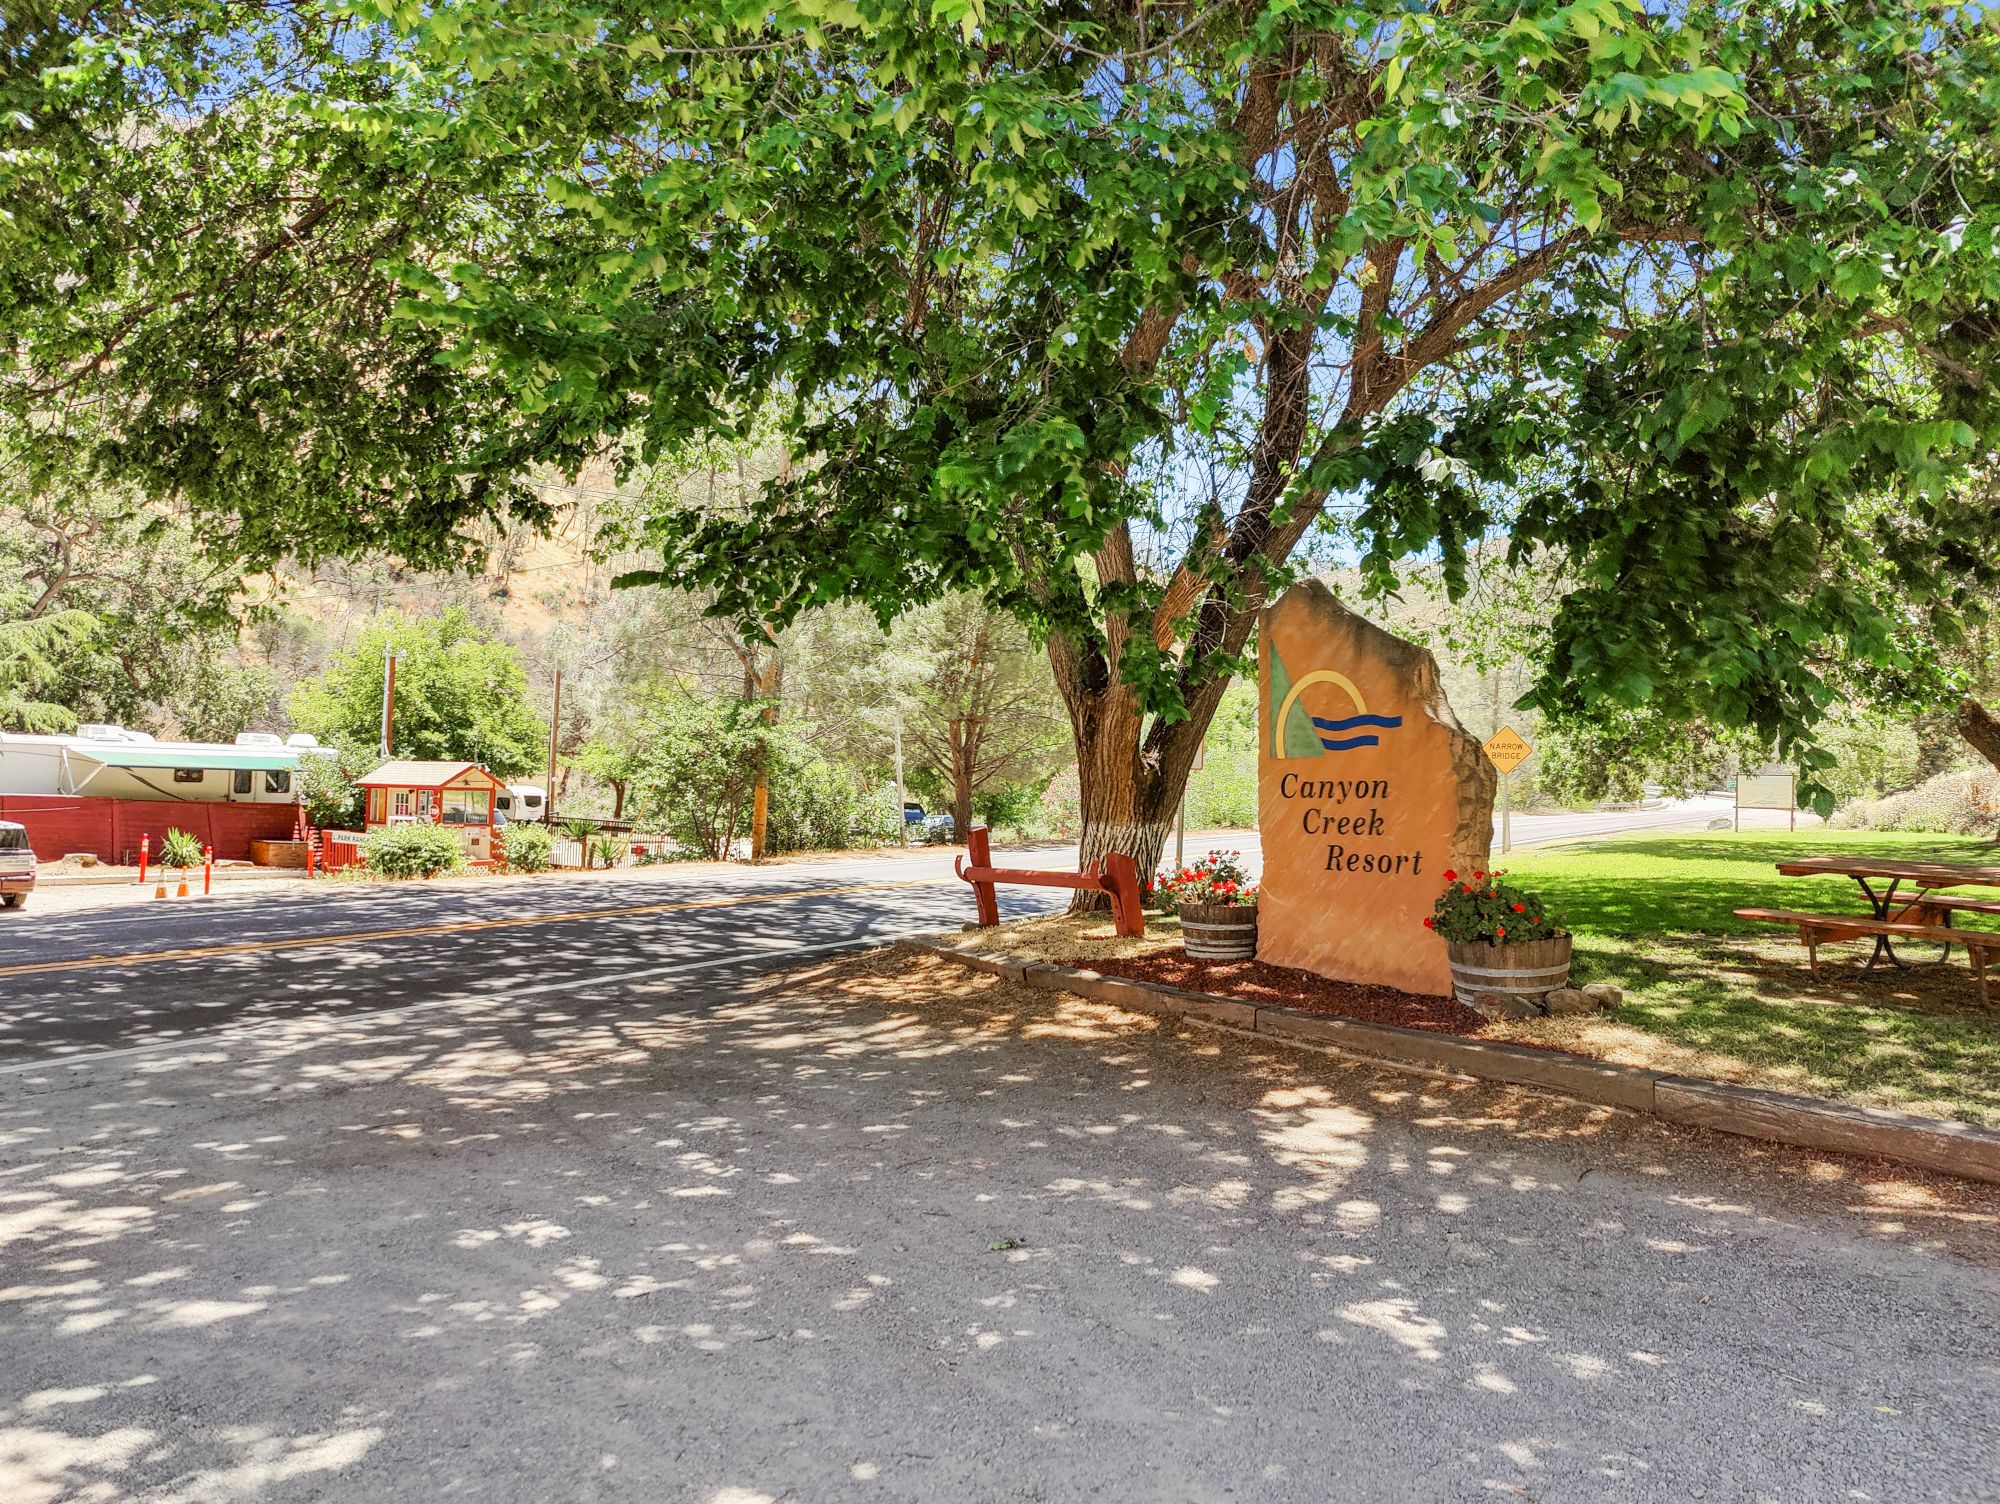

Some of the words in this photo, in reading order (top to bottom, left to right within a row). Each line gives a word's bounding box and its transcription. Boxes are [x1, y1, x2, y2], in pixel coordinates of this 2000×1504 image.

[1491, 752, 1521, 760] BRIDGE
[1280, 773, 1389, 804] Canyon
[1303, 808, 1385, 836] Creek
[337, 834, 351, 842] PARK
[1325, 844, 1423, 876] Resort
